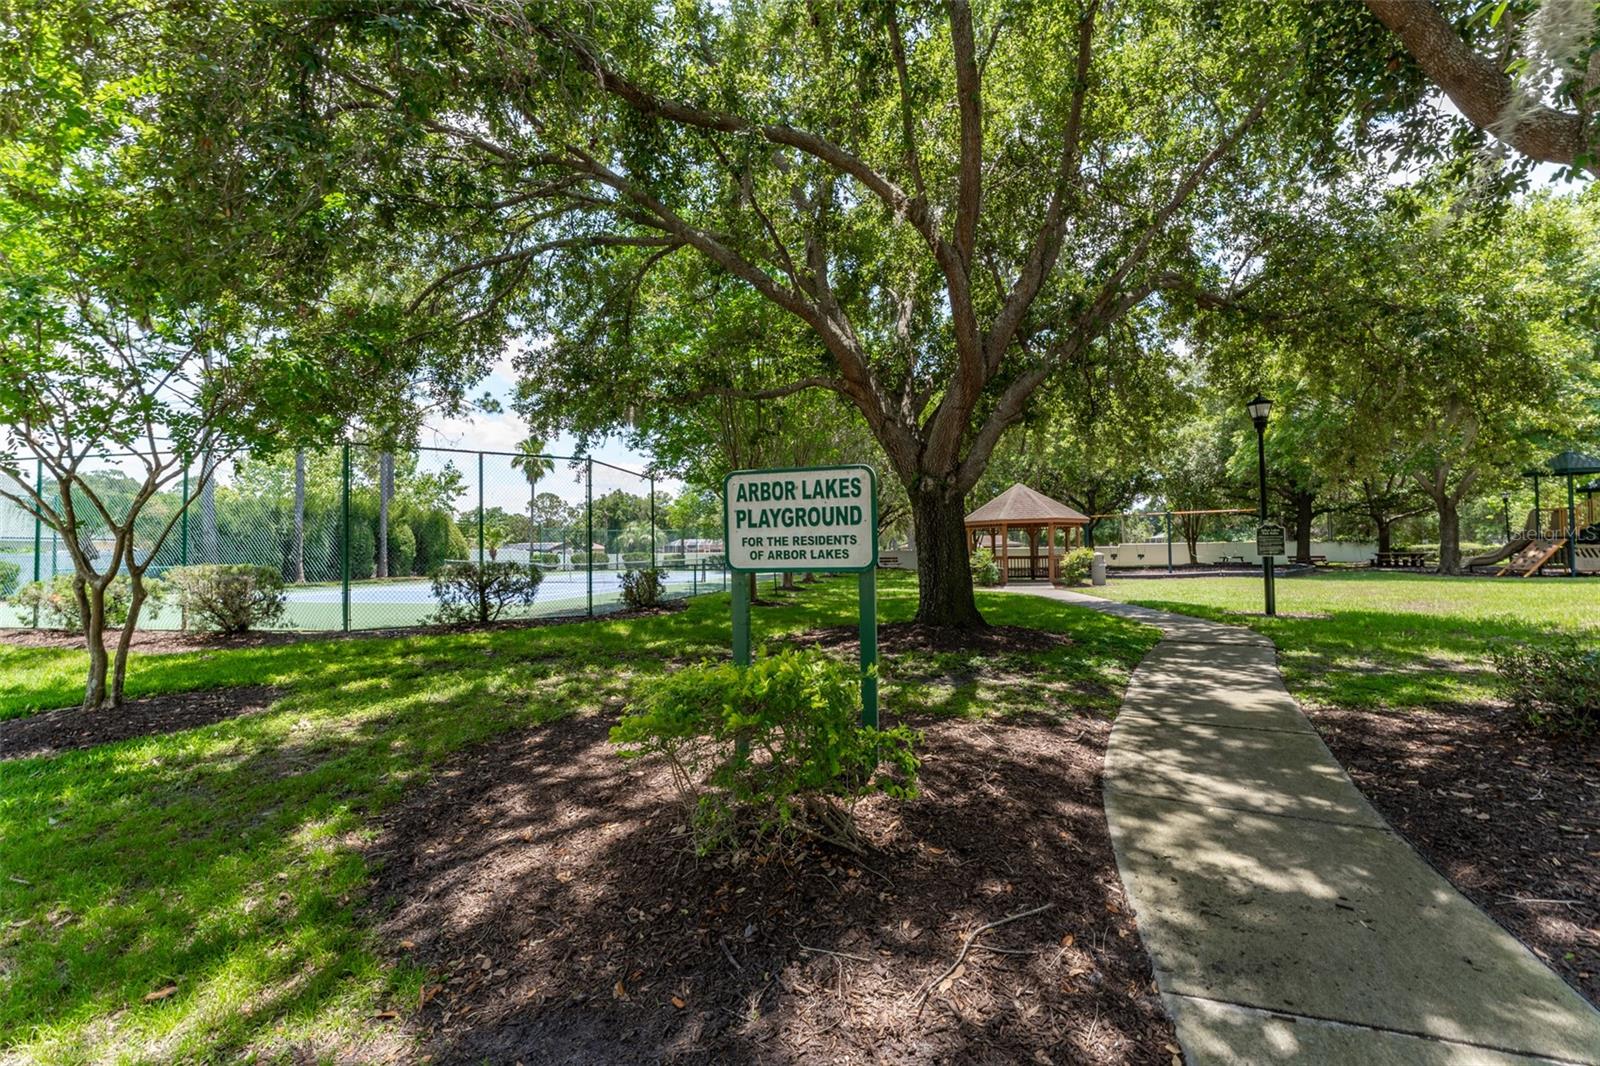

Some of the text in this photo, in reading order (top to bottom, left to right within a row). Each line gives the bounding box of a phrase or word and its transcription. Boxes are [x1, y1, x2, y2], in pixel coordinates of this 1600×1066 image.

[736, 477, 862, 502] ARBOR LAKES
[735, 505, 862, 529] PLAYGROUND
[742, 534, 857, 547] FOR THE RESIDENTS
[750, 548, 849, 560] OF ARBOR LAKES
